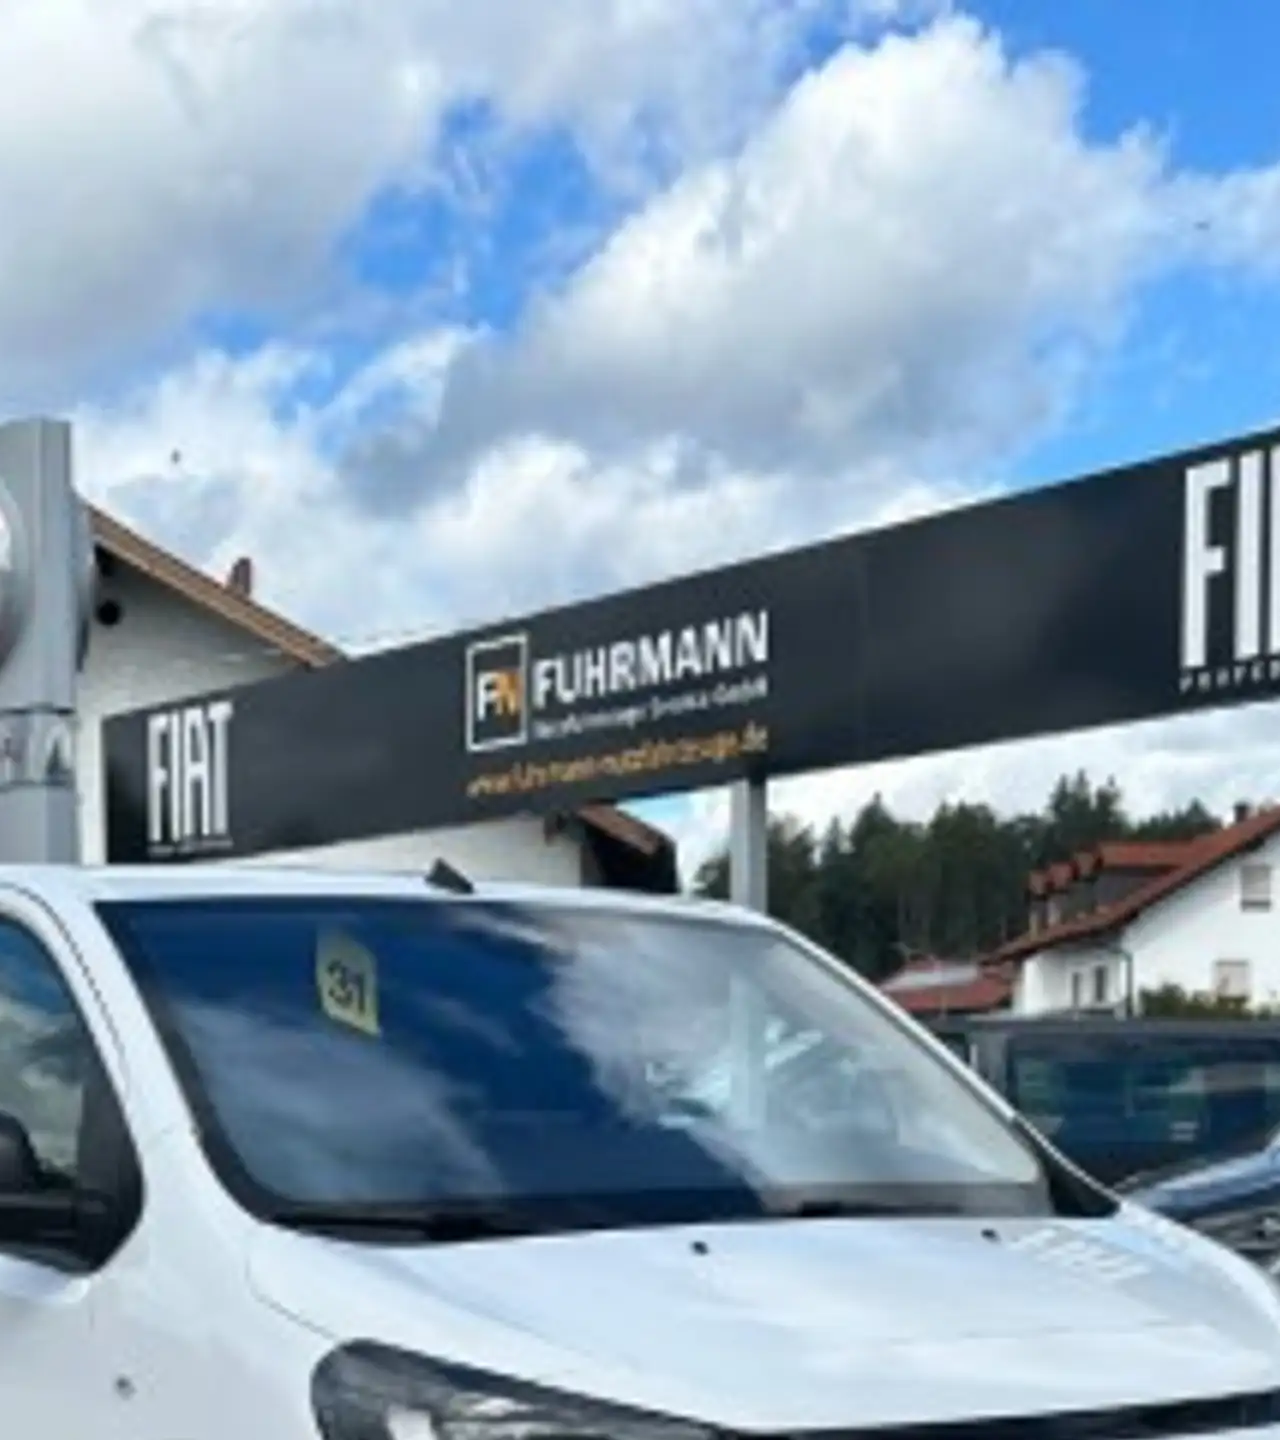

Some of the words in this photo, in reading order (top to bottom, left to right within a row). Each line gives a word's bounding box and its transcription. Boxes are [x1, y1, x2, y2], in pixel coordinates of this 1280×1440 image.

[532, 608, 769, 710] FUHRMANN
[147, 701, 234, 843] FIAT
[326, 957, 367, 1014] 31
